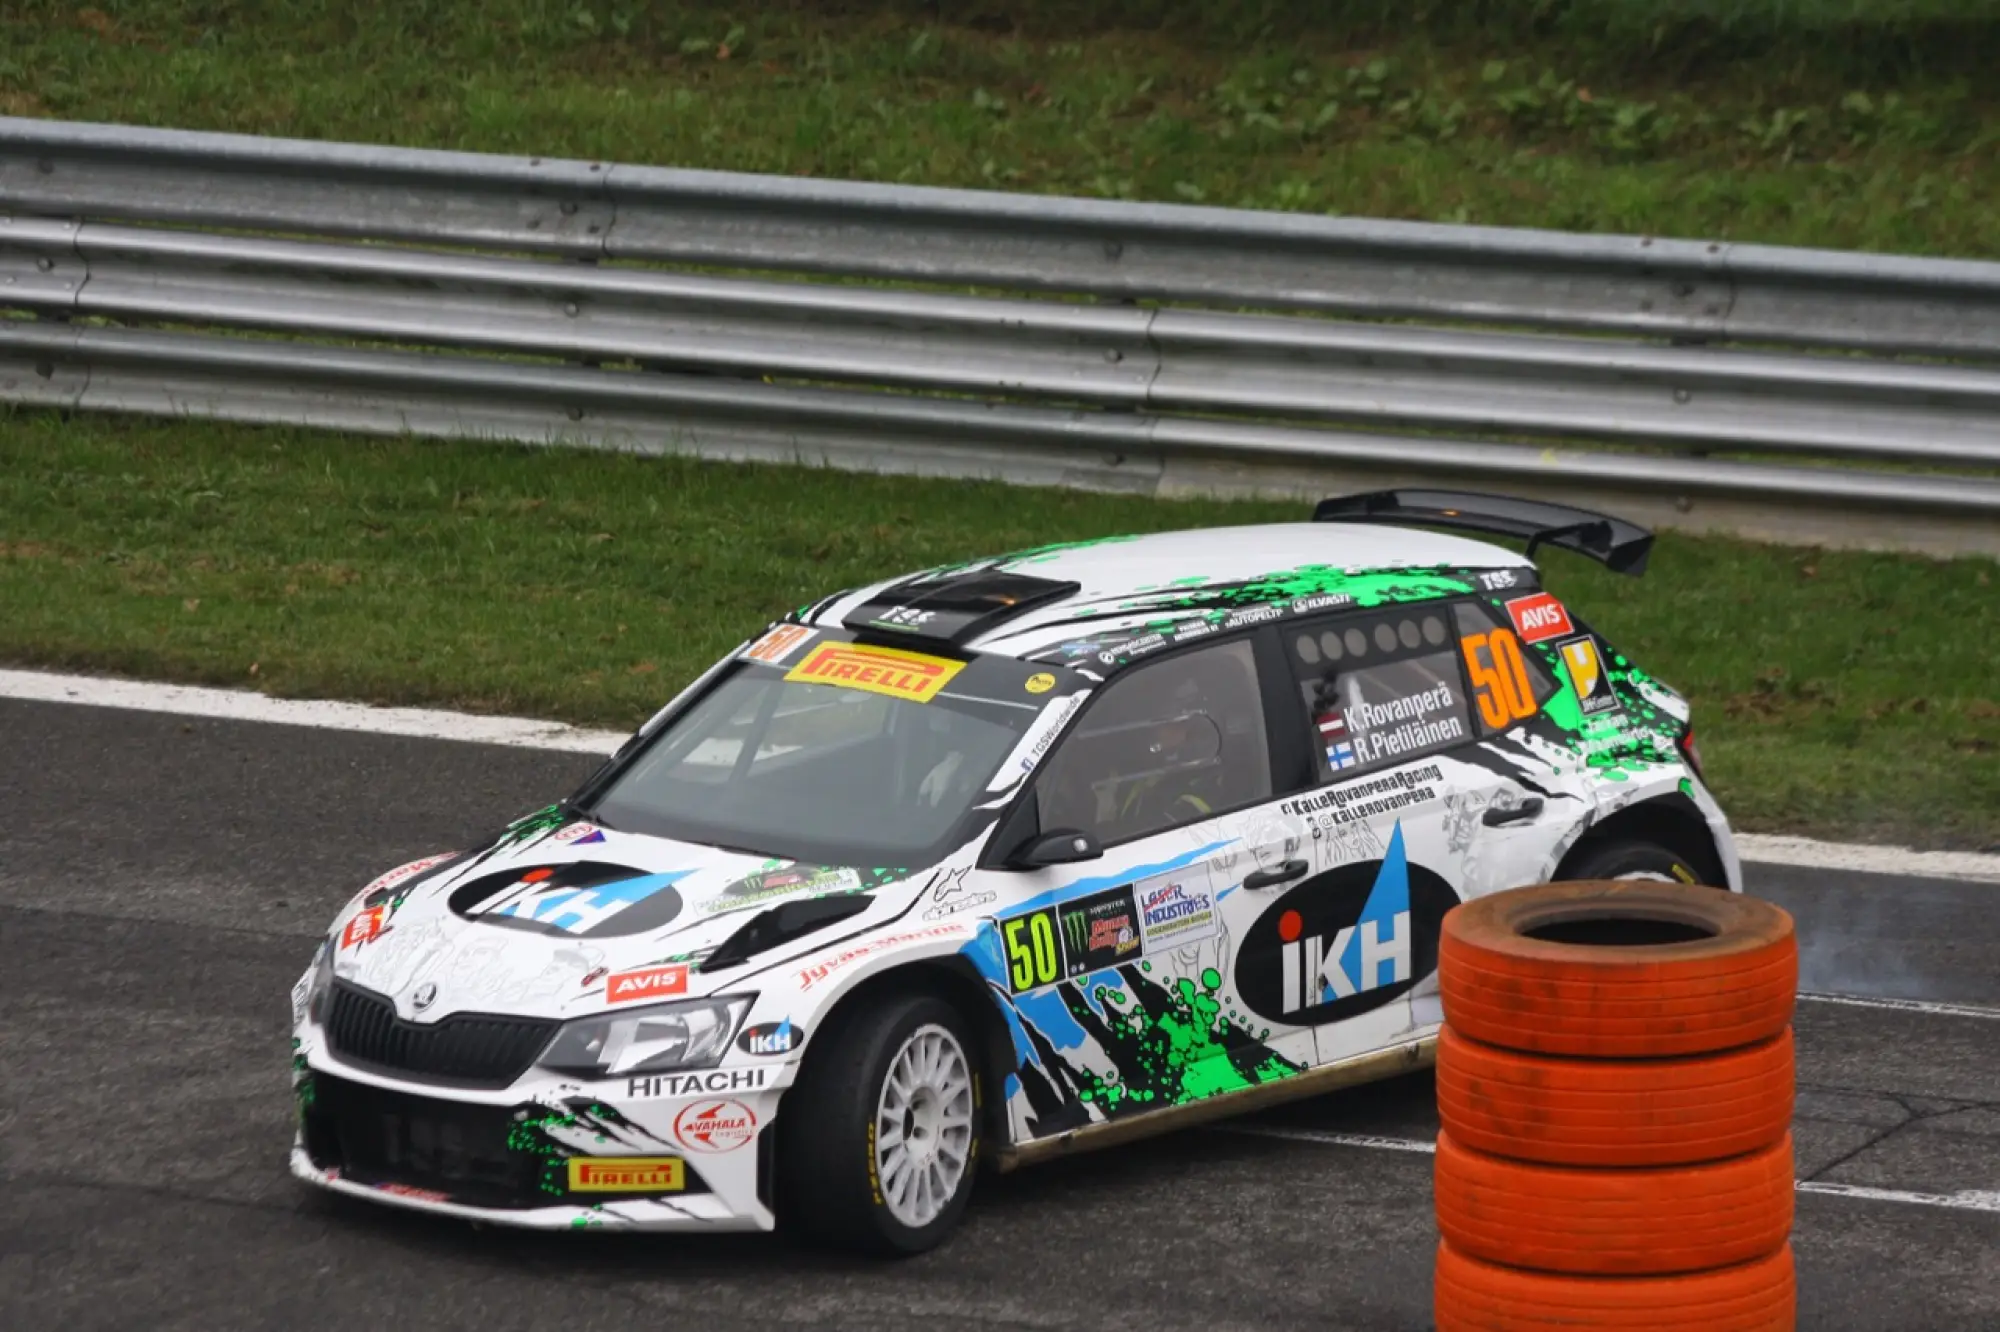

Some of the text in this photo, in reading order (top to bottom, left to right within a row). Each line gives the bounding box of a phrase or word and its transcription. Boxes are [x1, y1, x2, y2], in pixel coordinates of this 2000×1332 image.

[1521, 603, 1561, 631] AVIS
[750, 624, 809, 660] 50
[801, 648, 946, 693] PIRELLI
[1461, 627, 1537, 729] 50
[1343, 681, 1453, 733] K.Rovanperä
[1353, 716, 1462, 765] R.Pietiläinen
[1141, 883, 1187, 909] LASER
[1144, 895, 1210, 927] INDUSTRIES
[1005, 912, 1057, 991] 50
[615, 971, 677, 994] AVIS
[627, 1069, 765, 1098] HITACHI
[694, 1116, 746, 1132] VAHALA
[580, 1164, 672, 1185] PIRELLI
